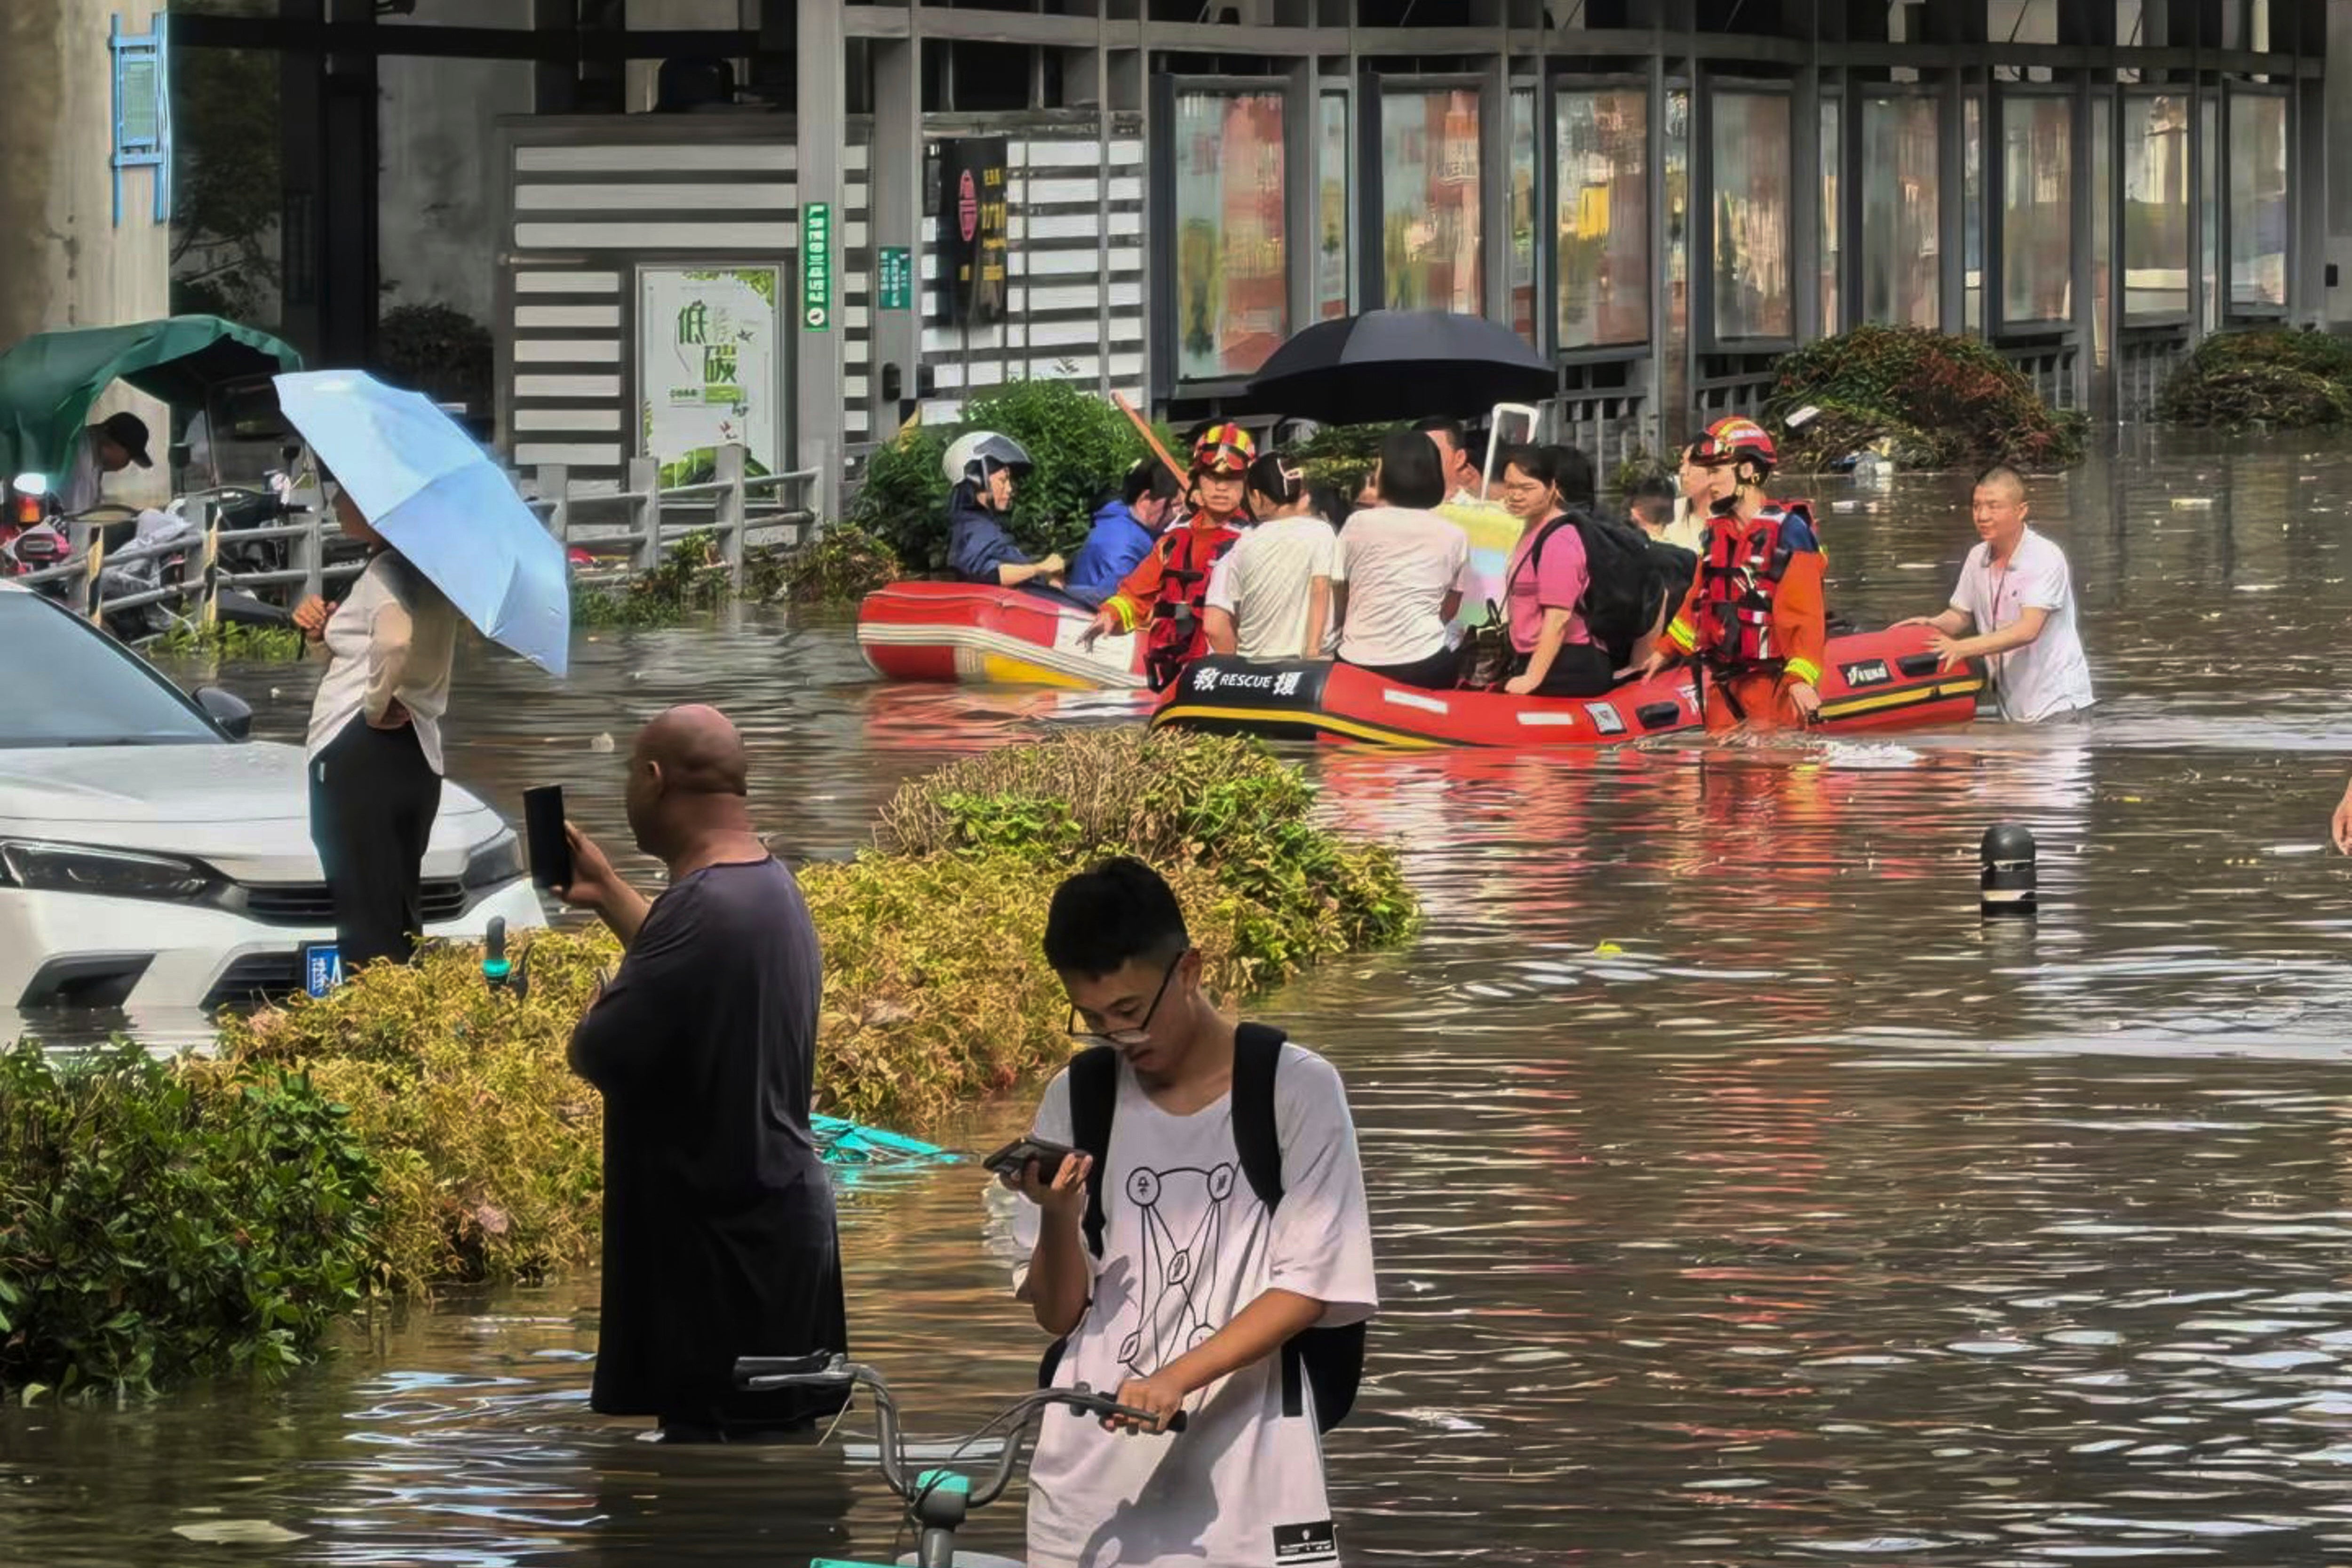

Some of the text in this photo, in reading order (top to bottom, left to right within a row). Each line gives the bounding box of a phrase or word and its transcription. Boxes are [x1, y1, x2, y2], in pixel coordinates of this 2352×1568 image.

[1193, 667, 1303, 695] 救 RESCUE 援
